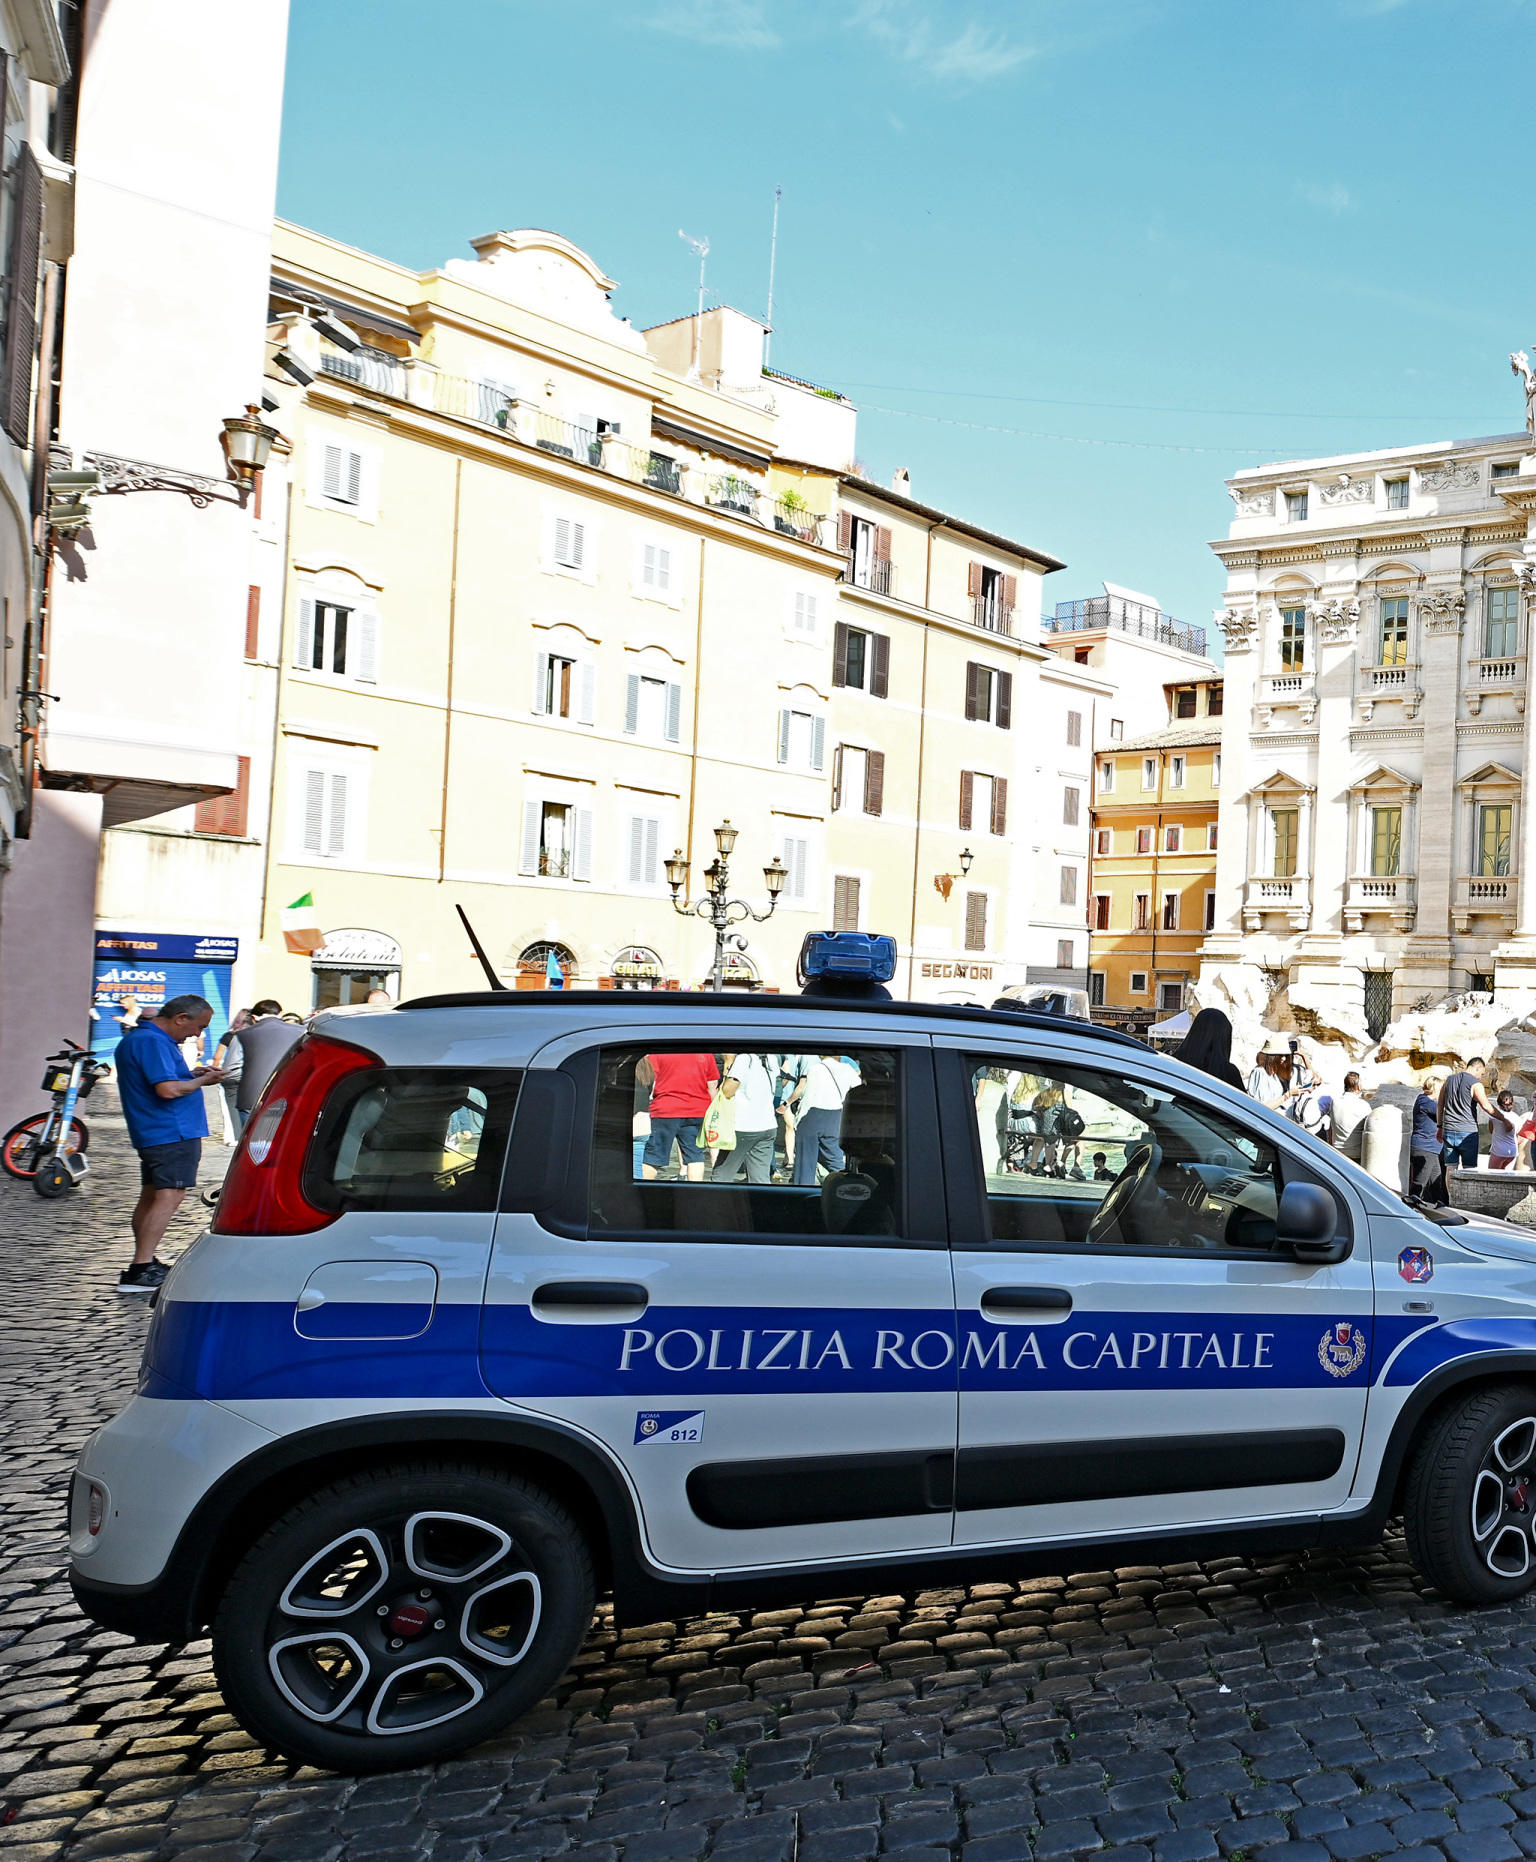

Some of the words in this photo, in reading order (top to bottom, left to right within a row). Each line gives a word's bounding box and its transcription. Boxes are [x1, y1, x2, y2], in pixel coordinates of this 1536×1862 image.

[120, 971, 167, 982] JOSAS
[921, 963, 993, 981] SEGATORI
[96, 983, 165, 993] AFFITTASI
[616, 1329, 854, 1371] POLIZIA
[872, 1330, 1048, 1371] ROMA
[1062, 1331, 1275, 1370] CAPITALE
[671, 1429, 697, 1441] 812
